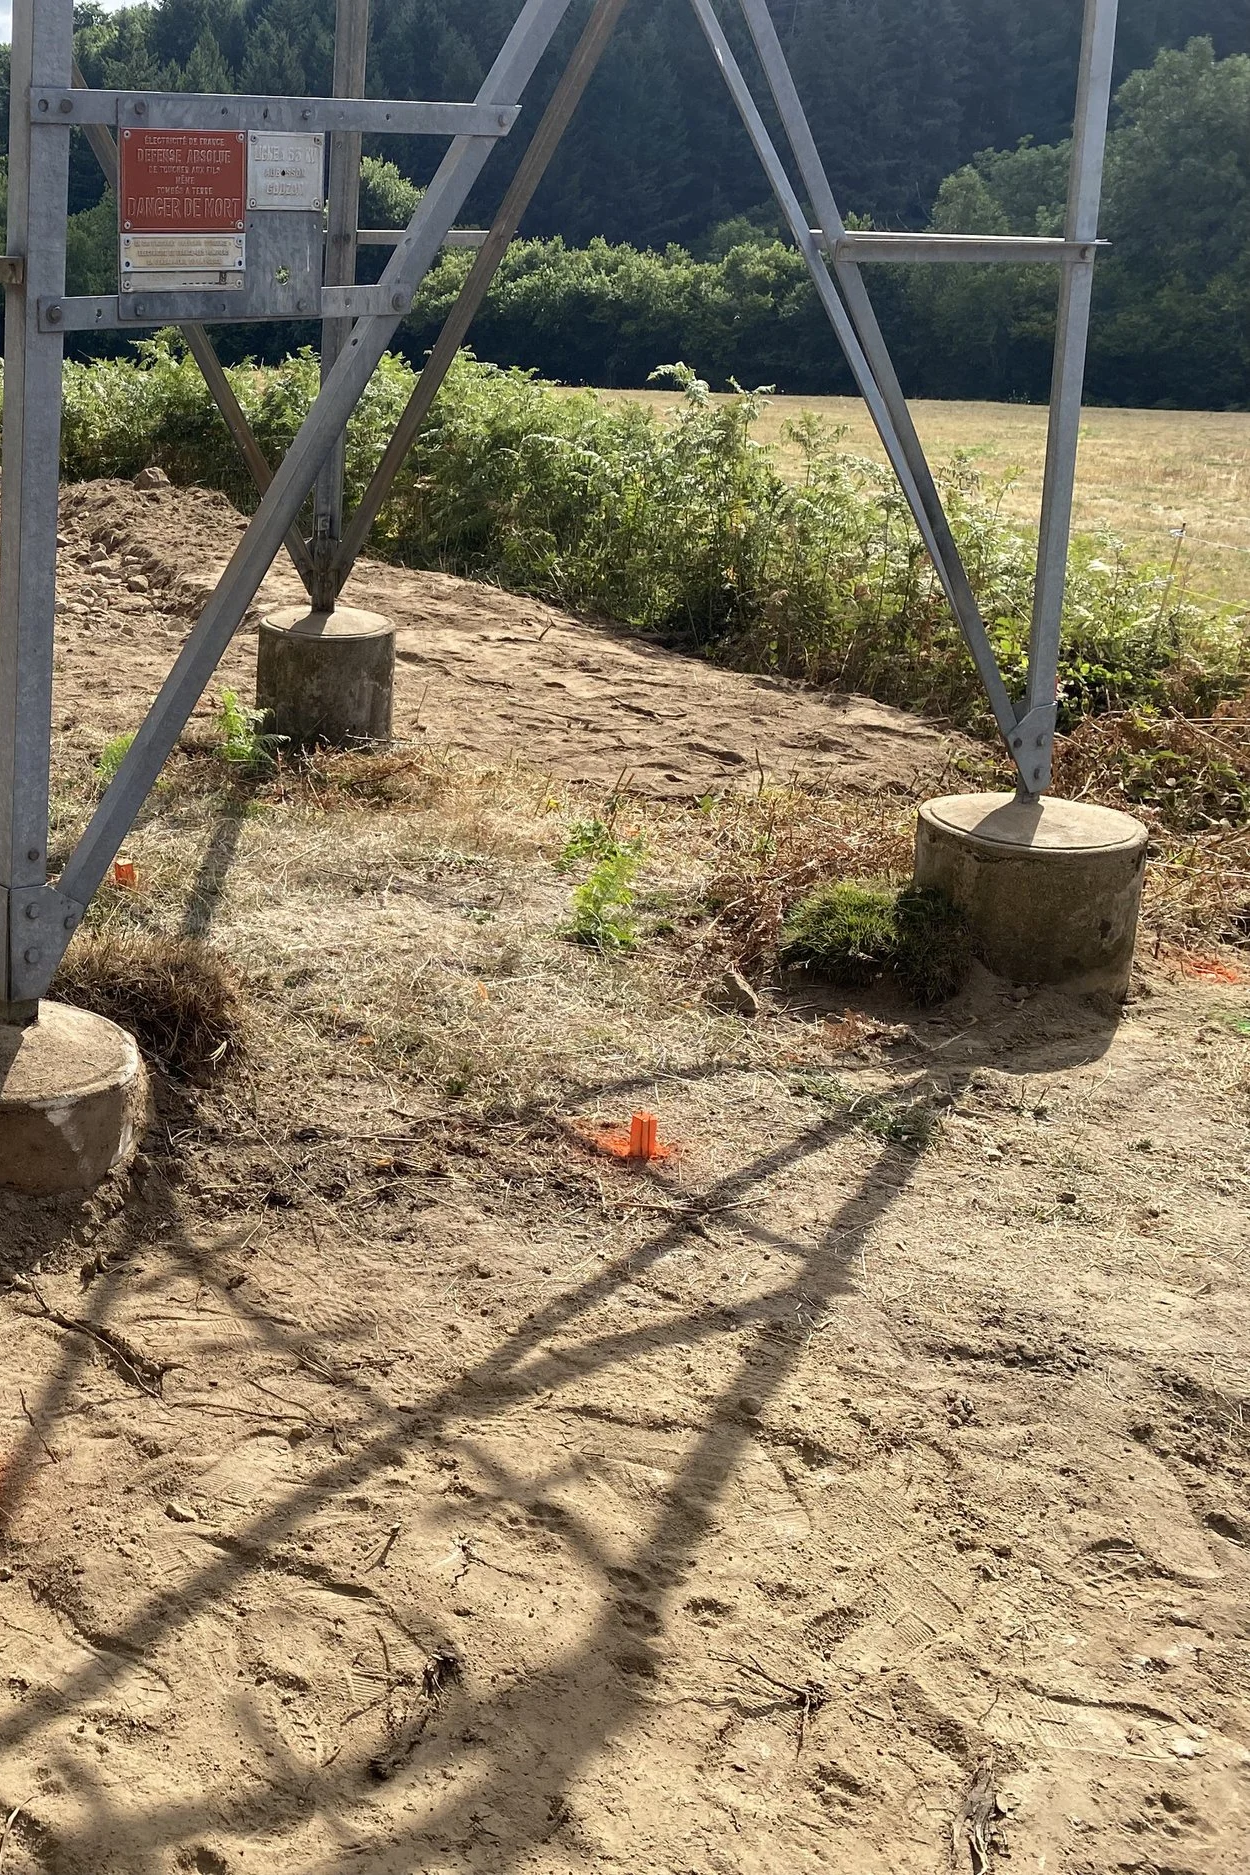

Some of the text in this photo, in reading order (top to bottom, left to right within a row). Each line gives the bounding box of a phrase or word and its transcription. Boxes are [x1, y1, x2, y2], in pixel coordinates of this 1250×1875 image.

[189, 137, 198, 146] DE
[199, 138, 225, 147] FRANCE
[186, 149, 231, 163] ABSOLUE
[254, 145, 279, 161] LIGNE
[160, 165, 189, 174] TOUCHER
[191, 165, 204, 174] AUX
[264, 167, 307, 179] AUBSSON
[192, 186, 213, 196] TERRE
[127, 197, 241, 219] DANGER DE MORT
